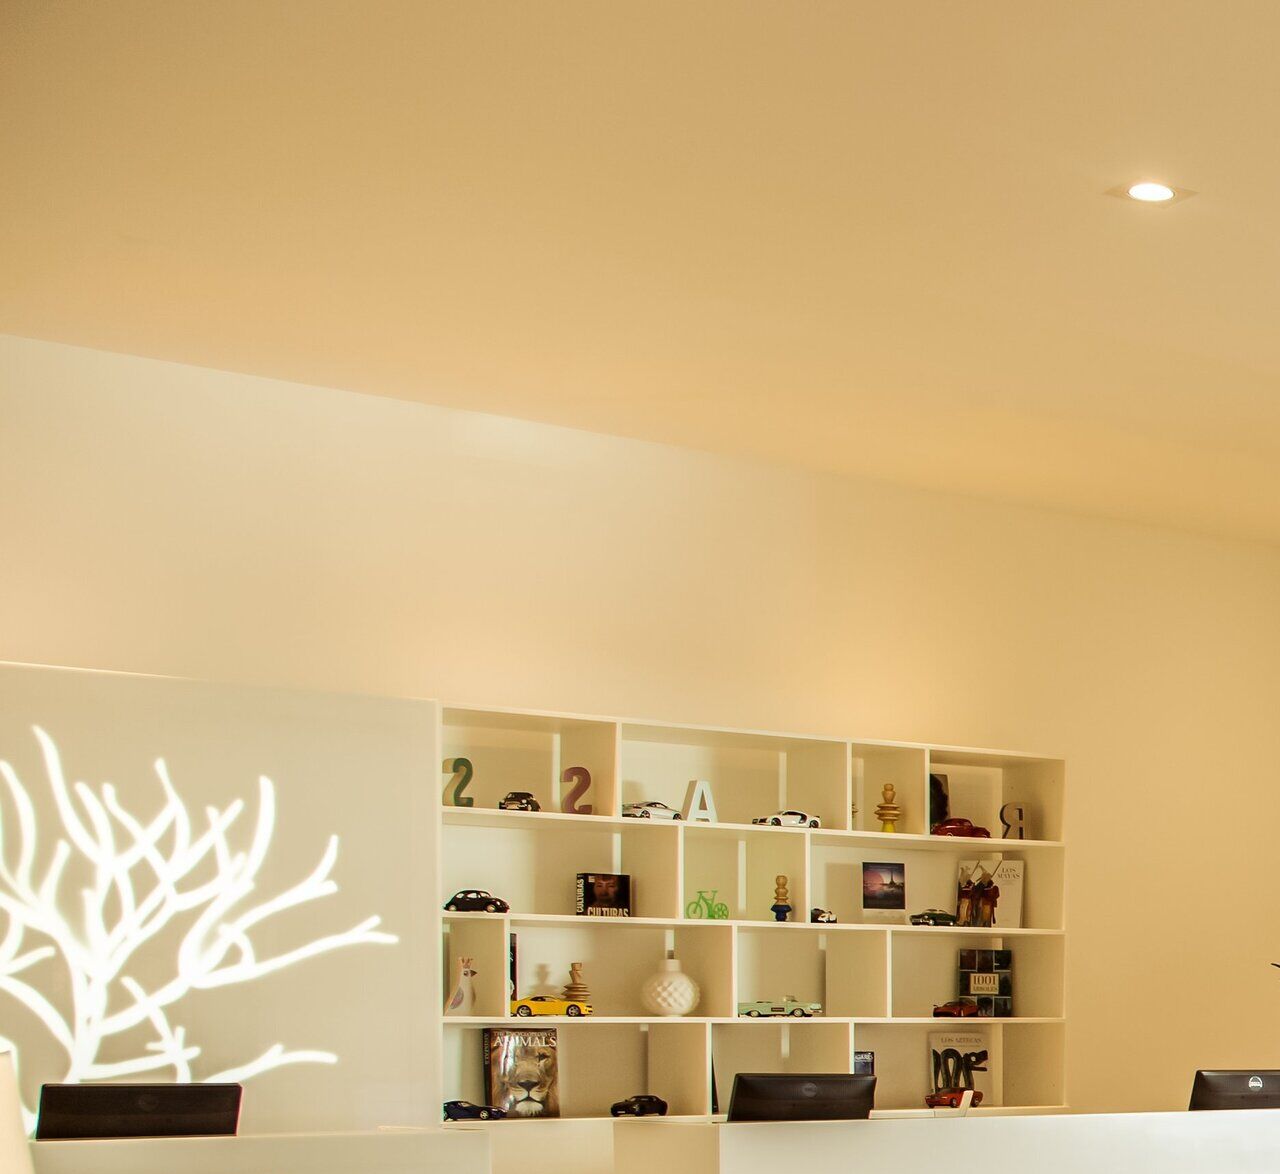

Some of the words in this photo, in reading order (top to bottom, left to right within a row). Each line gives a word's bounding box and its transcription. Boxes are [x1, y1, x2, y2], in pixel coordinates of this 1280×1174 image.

[682, 779, 718, 823] A
[576, 878, 585, 913] CULTURAS
[973, 975, 996, 985] 1001
[493, 1035, 557, 1047] ANIMALS
